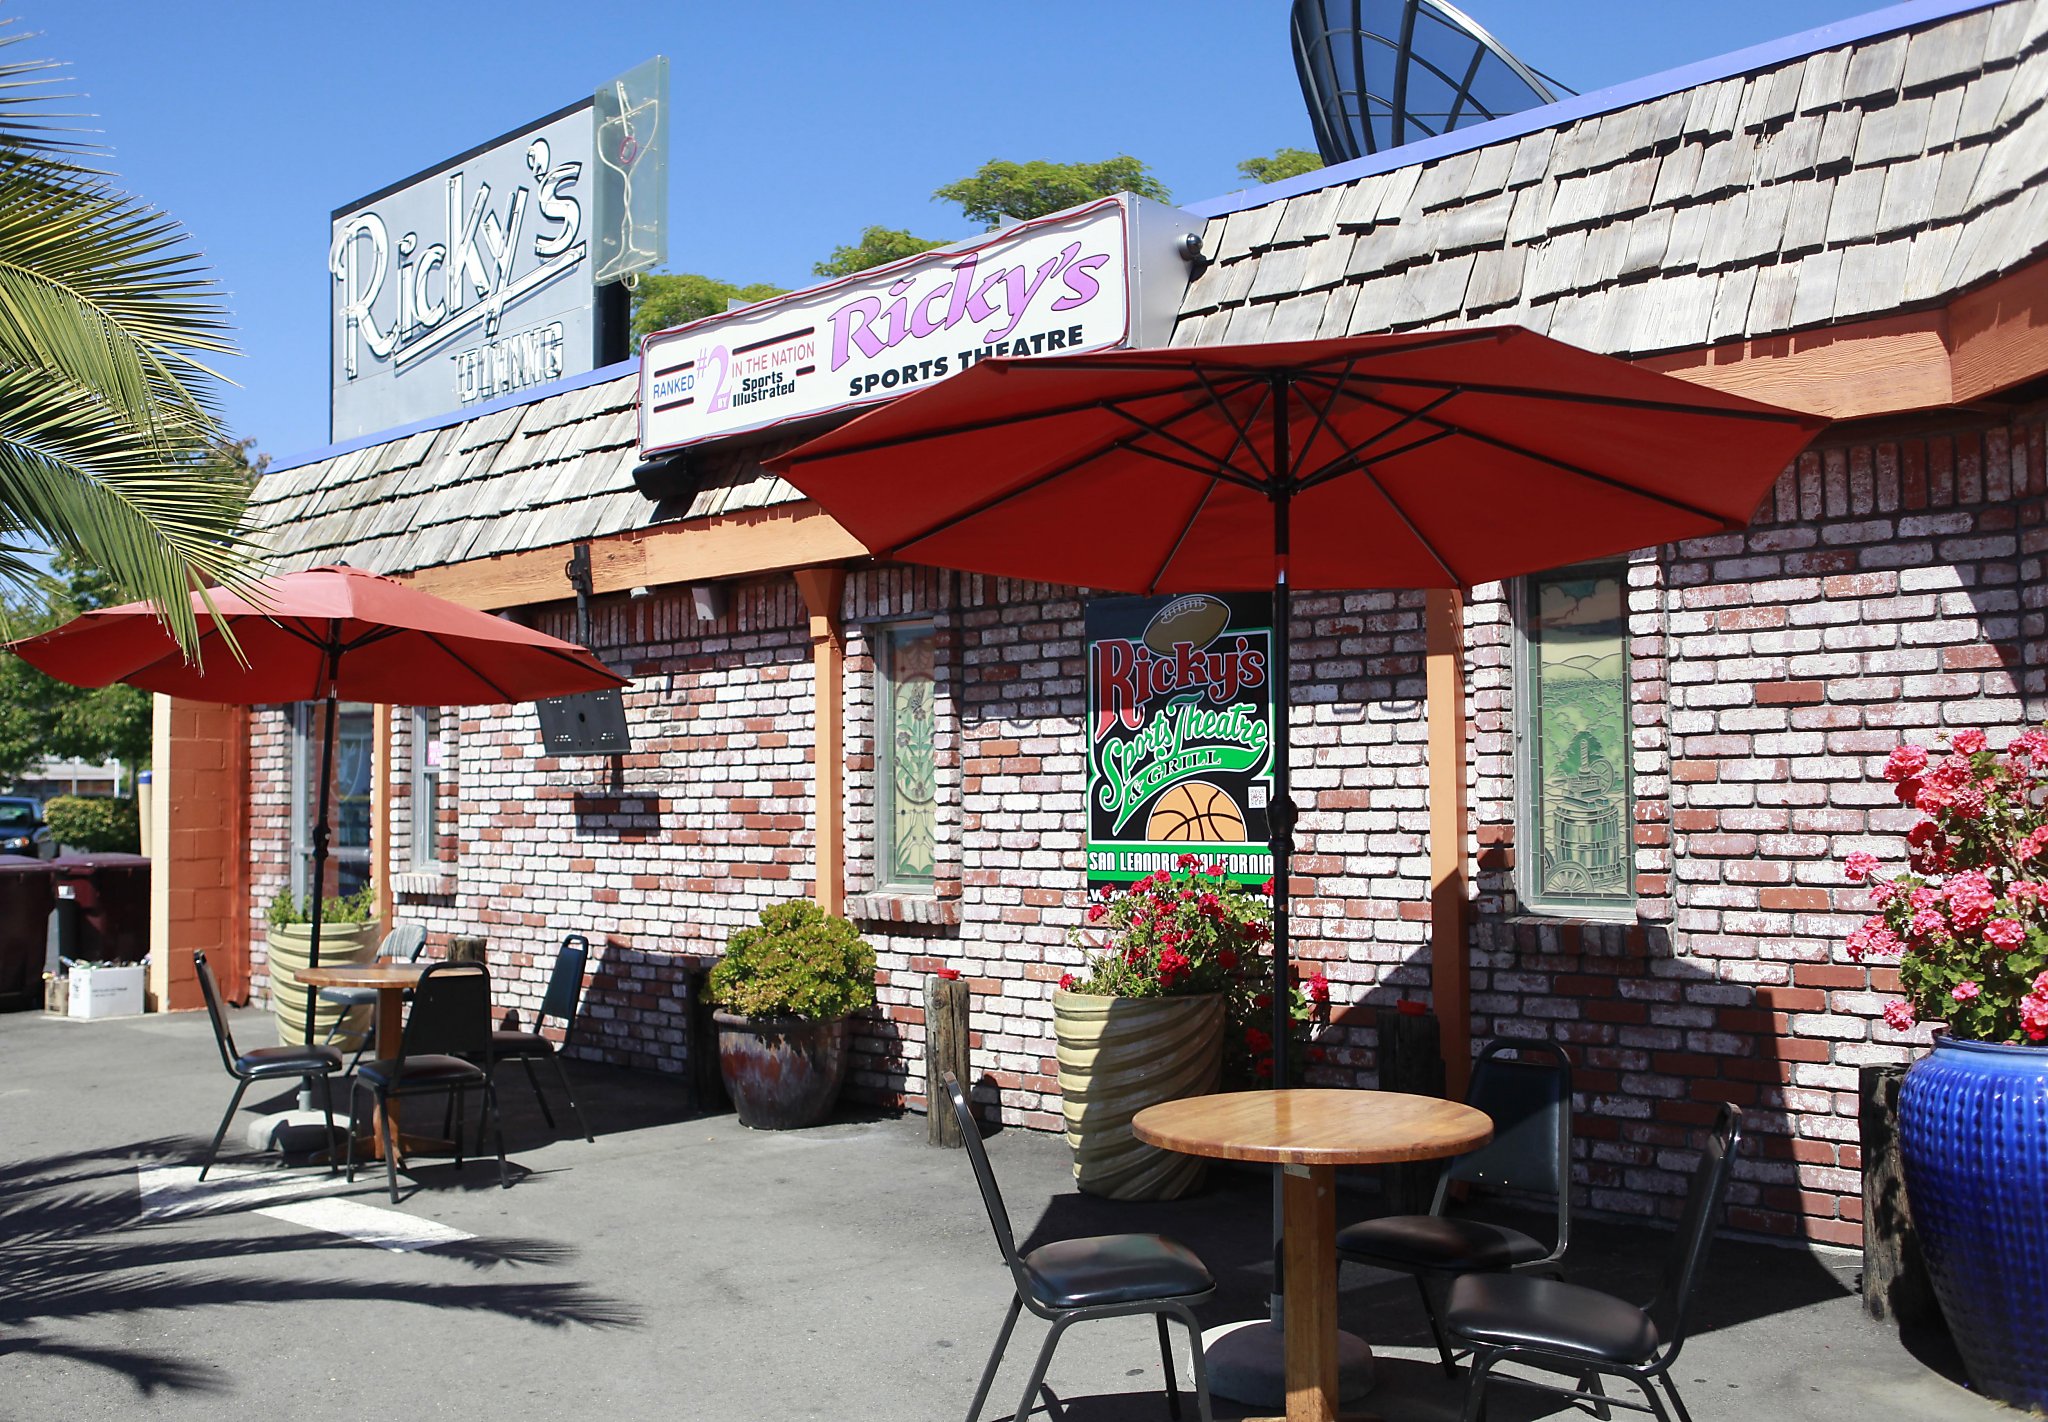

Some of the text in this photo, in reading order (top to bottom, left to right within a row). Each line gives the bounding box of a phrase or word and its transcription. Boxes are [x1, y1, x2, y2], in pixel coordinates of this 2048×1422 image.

[329, 137, 583, 379] Ricky's
[827, 241, 1110, 372] Ricky's
[653, 374, 695, 399] RANKED
[732, 341, 815, 378] IN THE NATION
[742, 371, 783, 393] Sports
[849, 324, 1084, 397] SPORTS THEATRE
[732, 380, 795, 407] Illustrated
[1095, 637, 1265, 744] Ricky's
[1099, 690, 1267, 812] Sports Theatre
[1128, 750, 1222, 805] & GRILL
[1088, 851, 1116, 871] SAN
